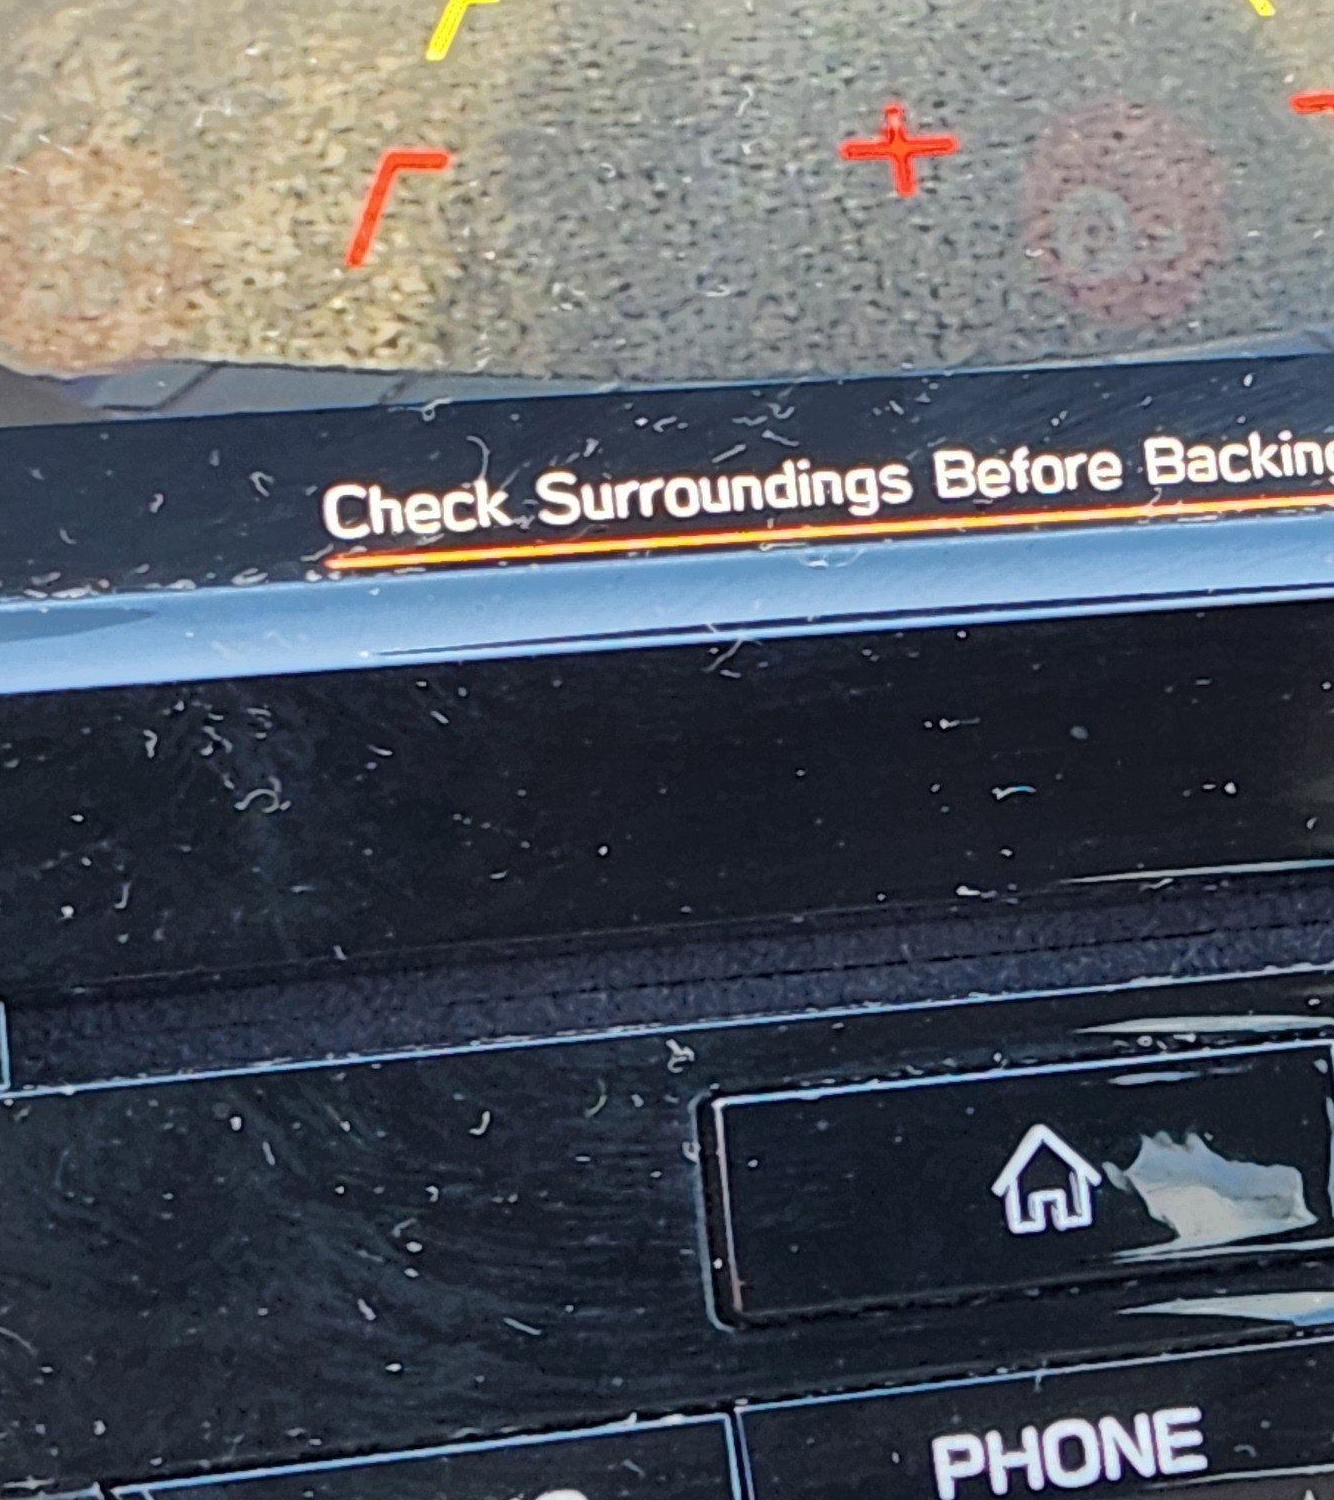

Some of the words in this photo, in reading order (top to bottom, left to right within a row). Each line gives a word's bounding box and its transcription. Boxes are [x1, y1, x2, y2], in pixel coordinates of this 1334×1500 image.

[322, 480, 514, 540] Check
[535, 457, 914, 525] Surroundings
[932, 445, 1123, 499] Before
[931, 1405, 1209, 1500] PHONE
